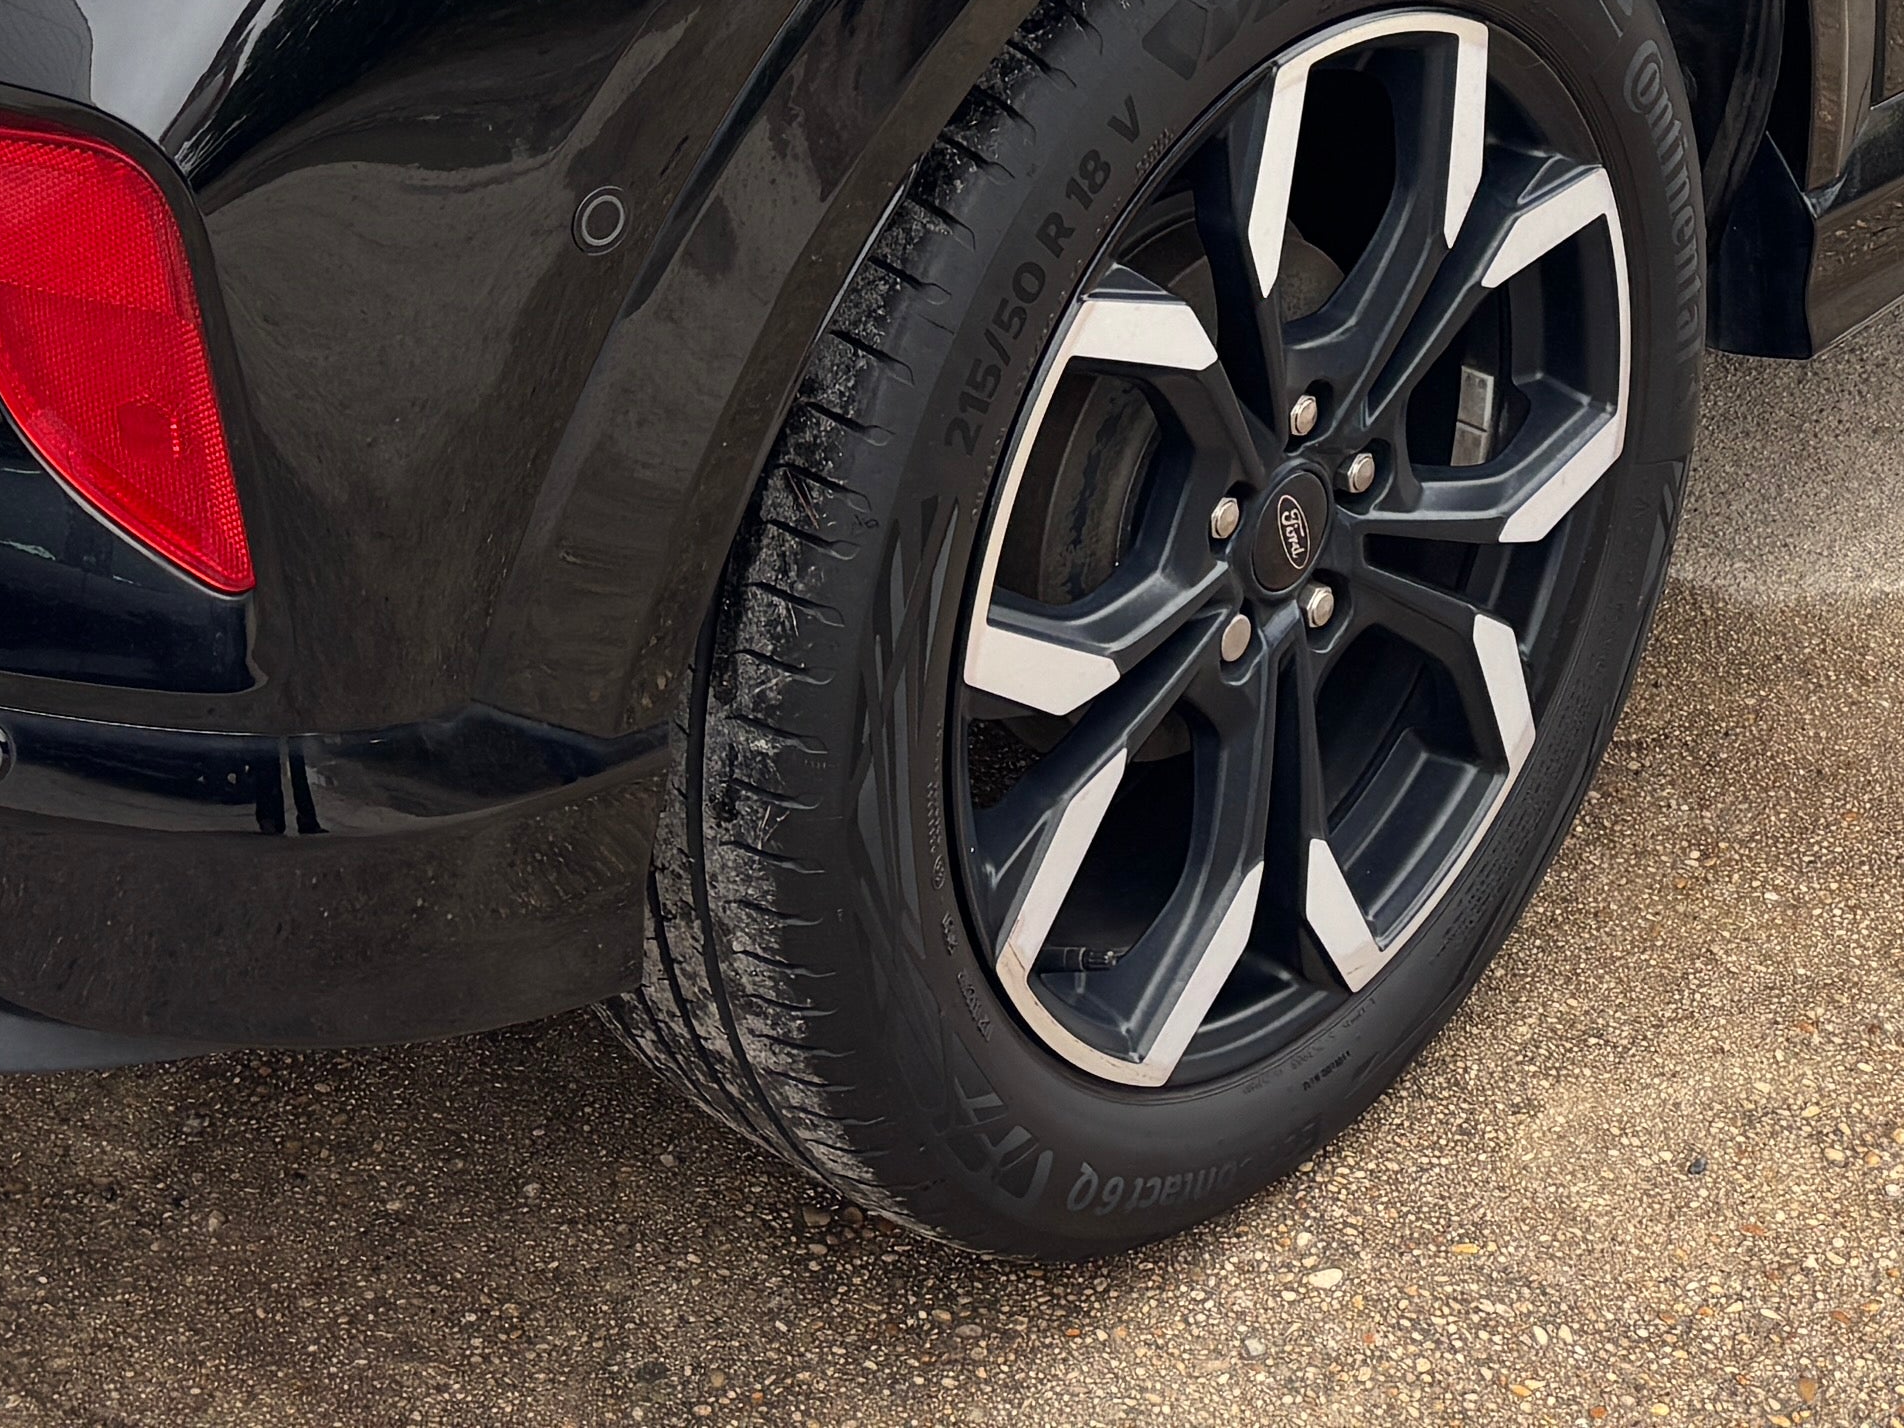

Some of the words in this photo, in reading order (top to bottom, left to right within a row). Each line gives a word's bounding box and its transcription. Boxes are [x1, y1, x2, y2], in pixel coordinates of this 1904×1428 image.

[944, 261, 1046, 456] 215/50
[1035, 211, 1076, 258] R
[1065, 148, 1112, 211] 18
[1623, 39, 1702, 365] Continental
[1281, 508, 1305, 559] Ford
